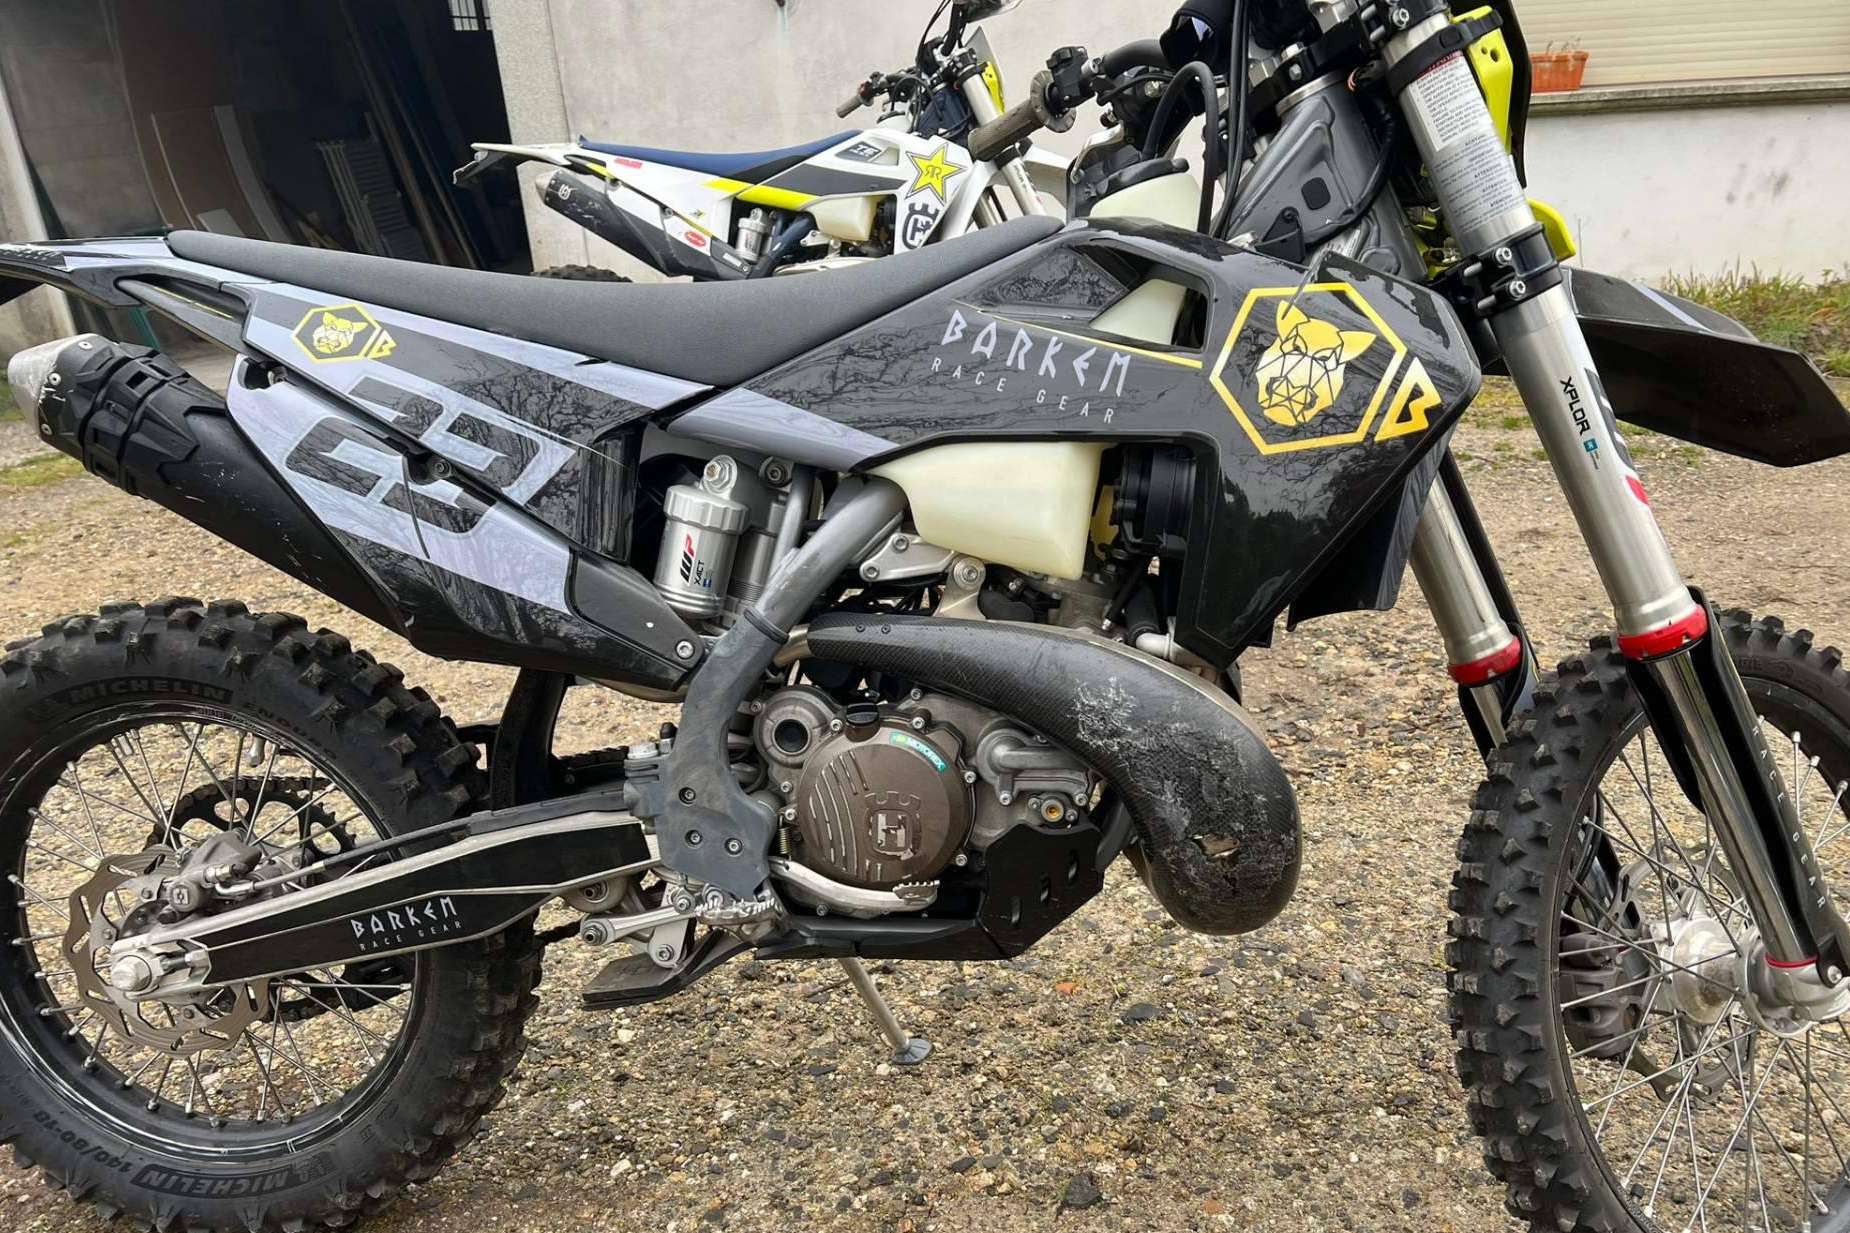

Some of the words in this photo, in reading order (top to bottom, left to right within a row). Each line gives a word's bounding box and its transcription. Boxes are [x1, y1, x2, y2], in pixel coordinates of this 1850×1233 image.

[940, 309, 1131, 398] BARKEM
[931, 356, 1006, 392] RACE
[1036, 389, 1115, 424] GEAR
[1560, 376, 1591, 436] XPLOR
[694, 560, 705, 585] XACT
[69, 677, 228, 704] MICHELIN
[1752, 724, 1785, 803] RACE
[1791, 831, 1827, 909] GEAR
[350, 896, 458, 939] BARKEM
[359, 934, 403, 951] RACE
[418, 920, 462, 937] GEAR
[141, 1168, 289, 1197] MICHELIN
